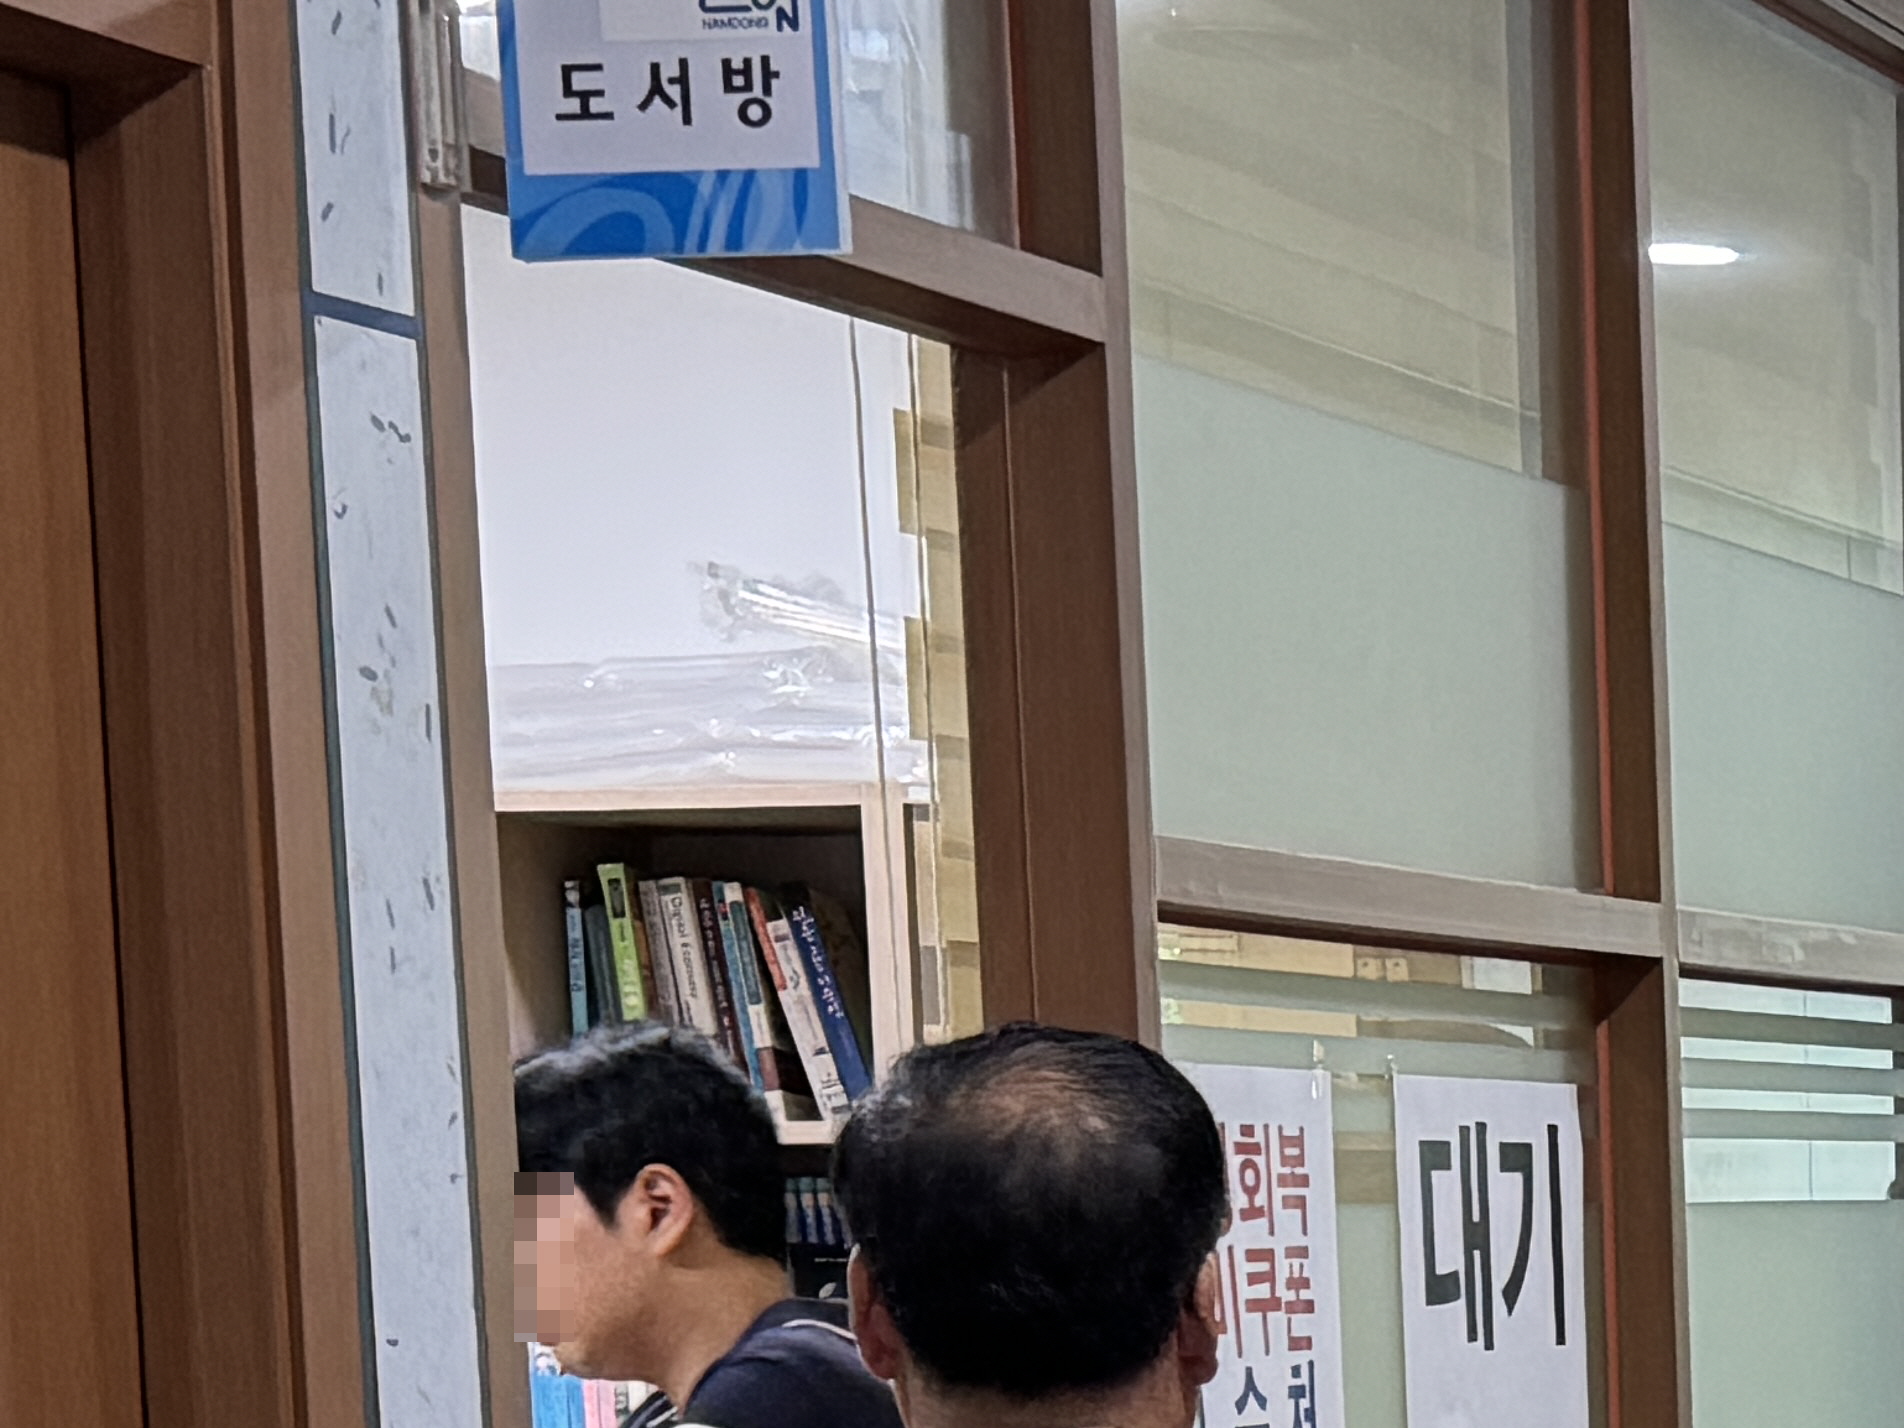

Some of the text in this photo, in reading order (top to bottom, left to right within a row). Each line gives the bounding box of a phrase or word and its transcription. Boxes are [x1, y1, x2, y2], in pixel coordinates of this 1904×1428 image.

[554, 56, 780, 128] 도서방
[1220, 1121, 1310, 1237] 회복
[1418, 1121, 1566, 1351] 대기
